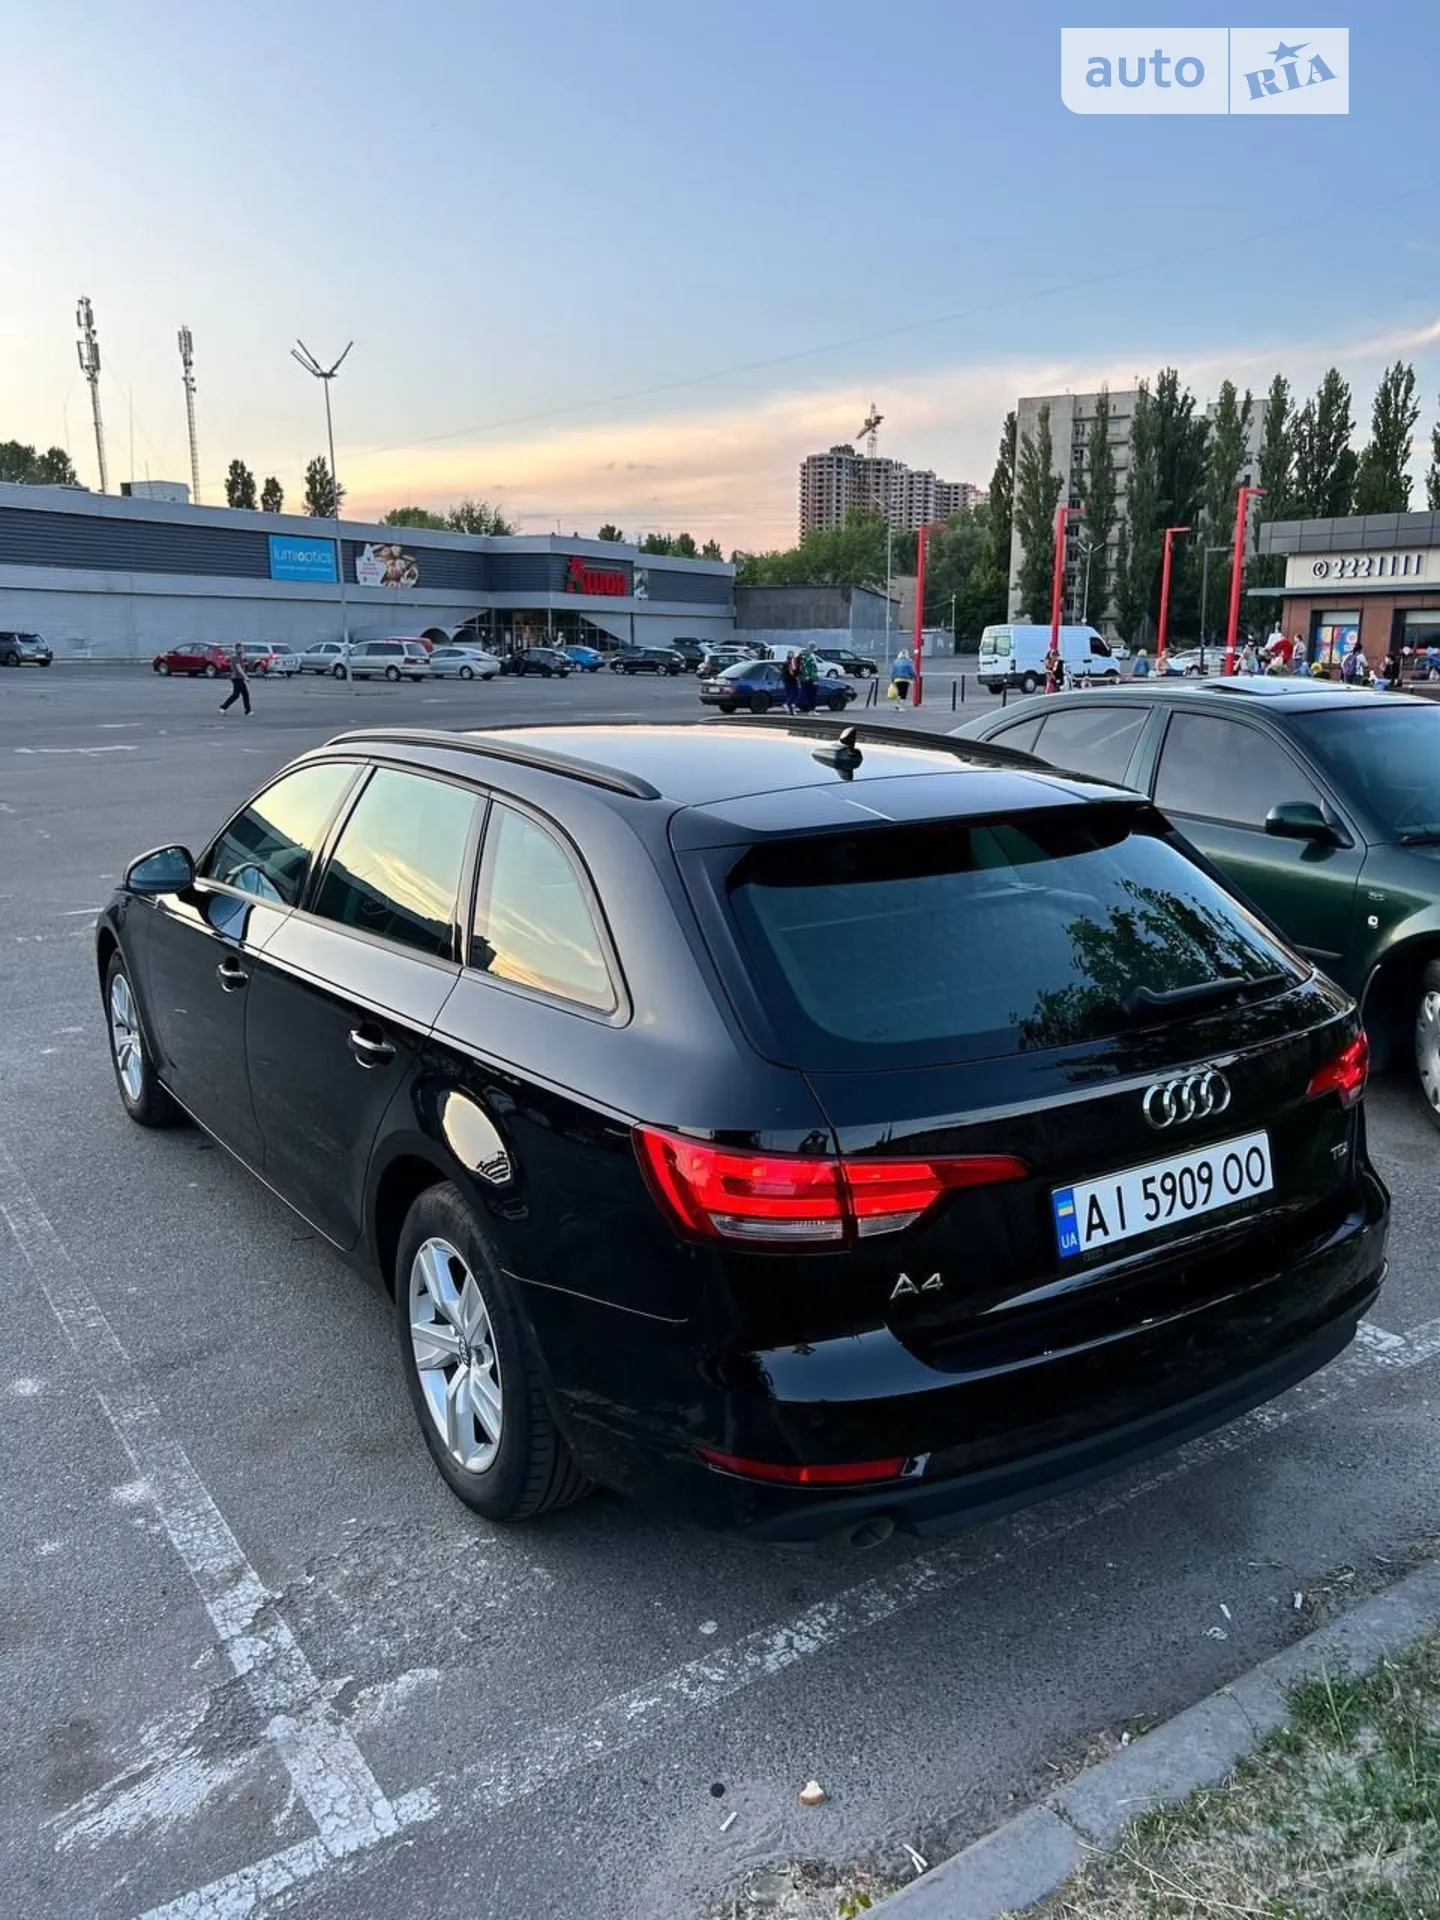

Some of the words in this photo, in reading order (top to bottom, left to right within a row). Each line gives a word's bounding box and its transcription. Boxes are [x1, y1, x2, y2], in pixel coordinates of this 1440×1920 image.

[274, 544, 333, 566] lumioptics
[1086, 1186, 1126, 1242] AI
[1142, 1161, 1213, 1221] 5909
[1223, 1146, 1265, 1195] OO
[1061, 1231, 1078, 1249] UA
[890, 1272, 944, 1300] A4
